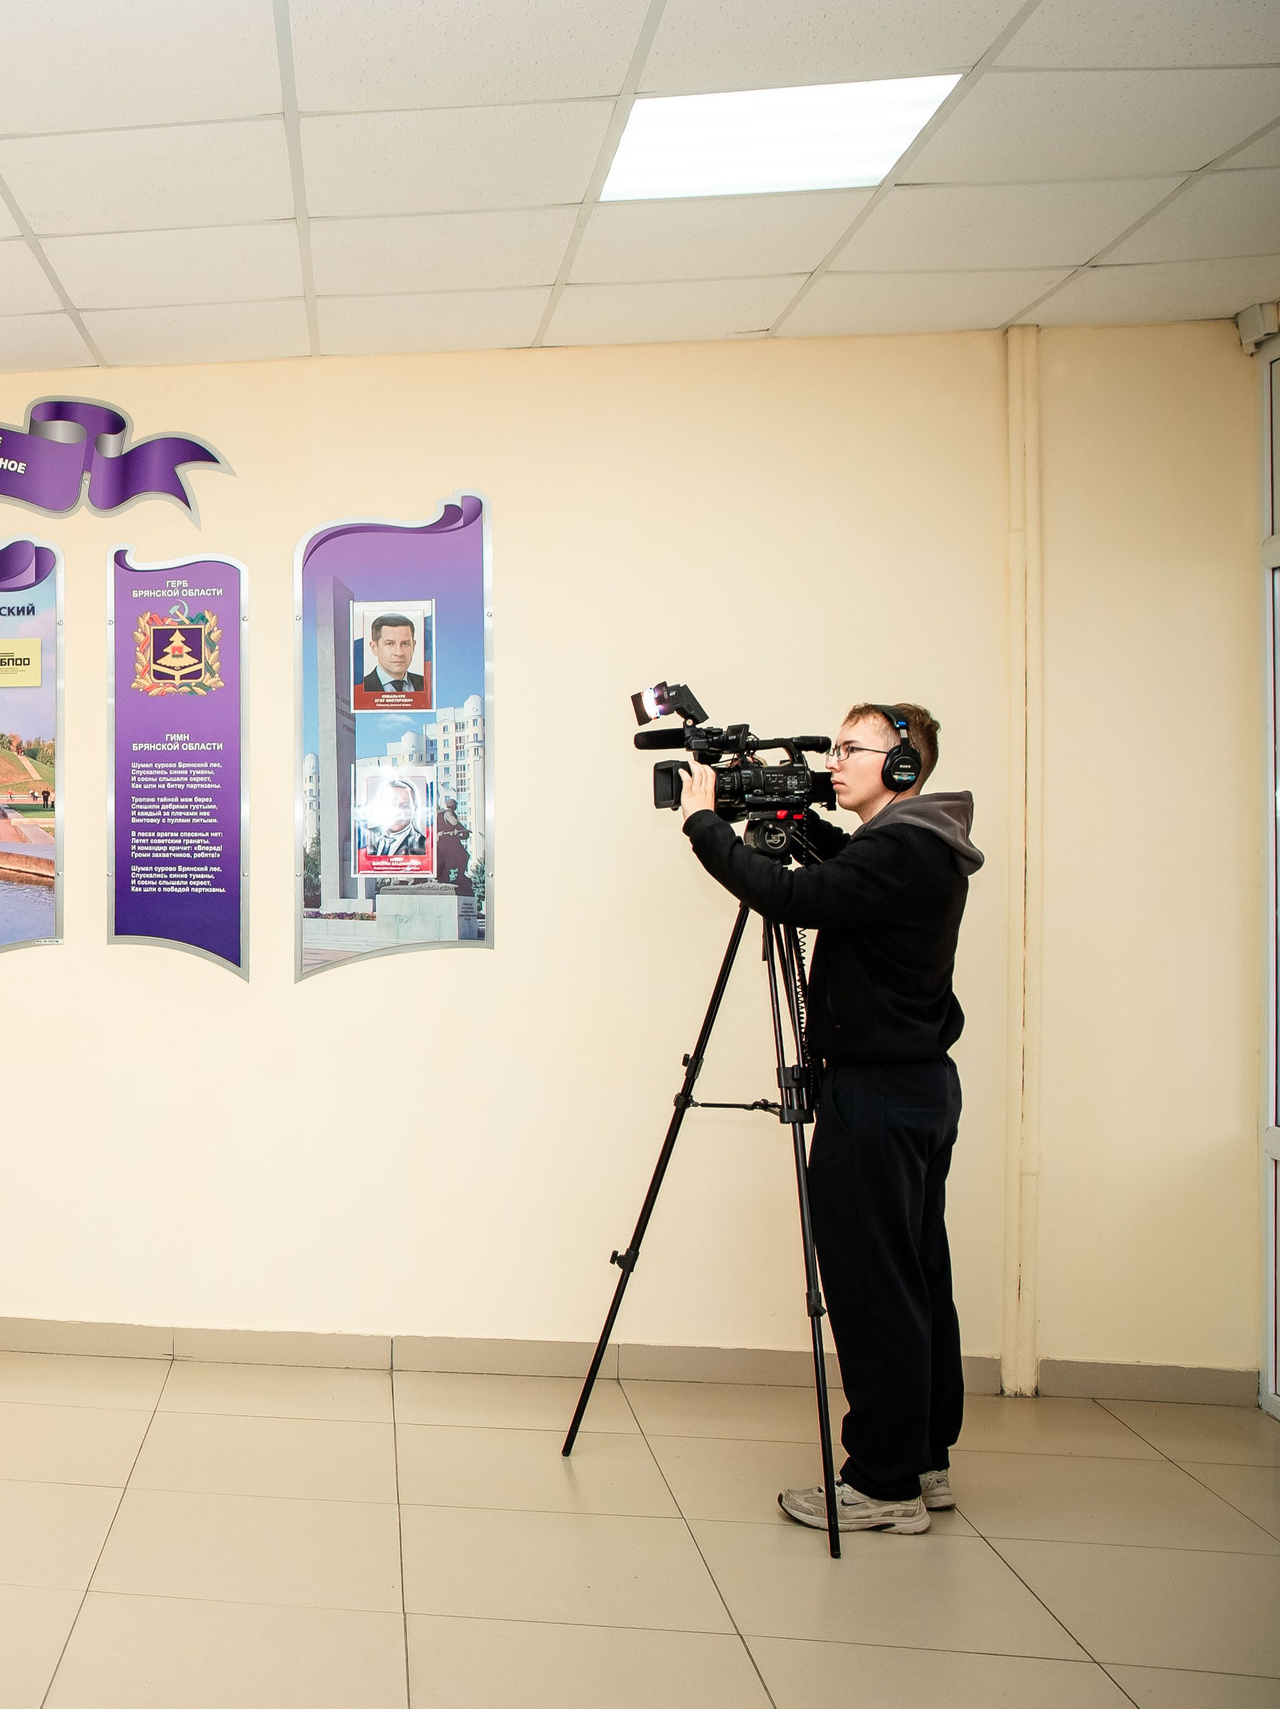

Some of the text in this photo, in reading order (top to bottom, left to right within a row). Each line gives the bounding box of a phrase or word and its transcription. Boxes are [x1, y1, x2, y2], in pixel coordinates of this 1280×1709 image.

[133, 588, 179, 597] БРЯНСКОЙ
[0, 657, 31, 667] БПОО
[133, 742, 179, 750] БРЯНСКОЙ
